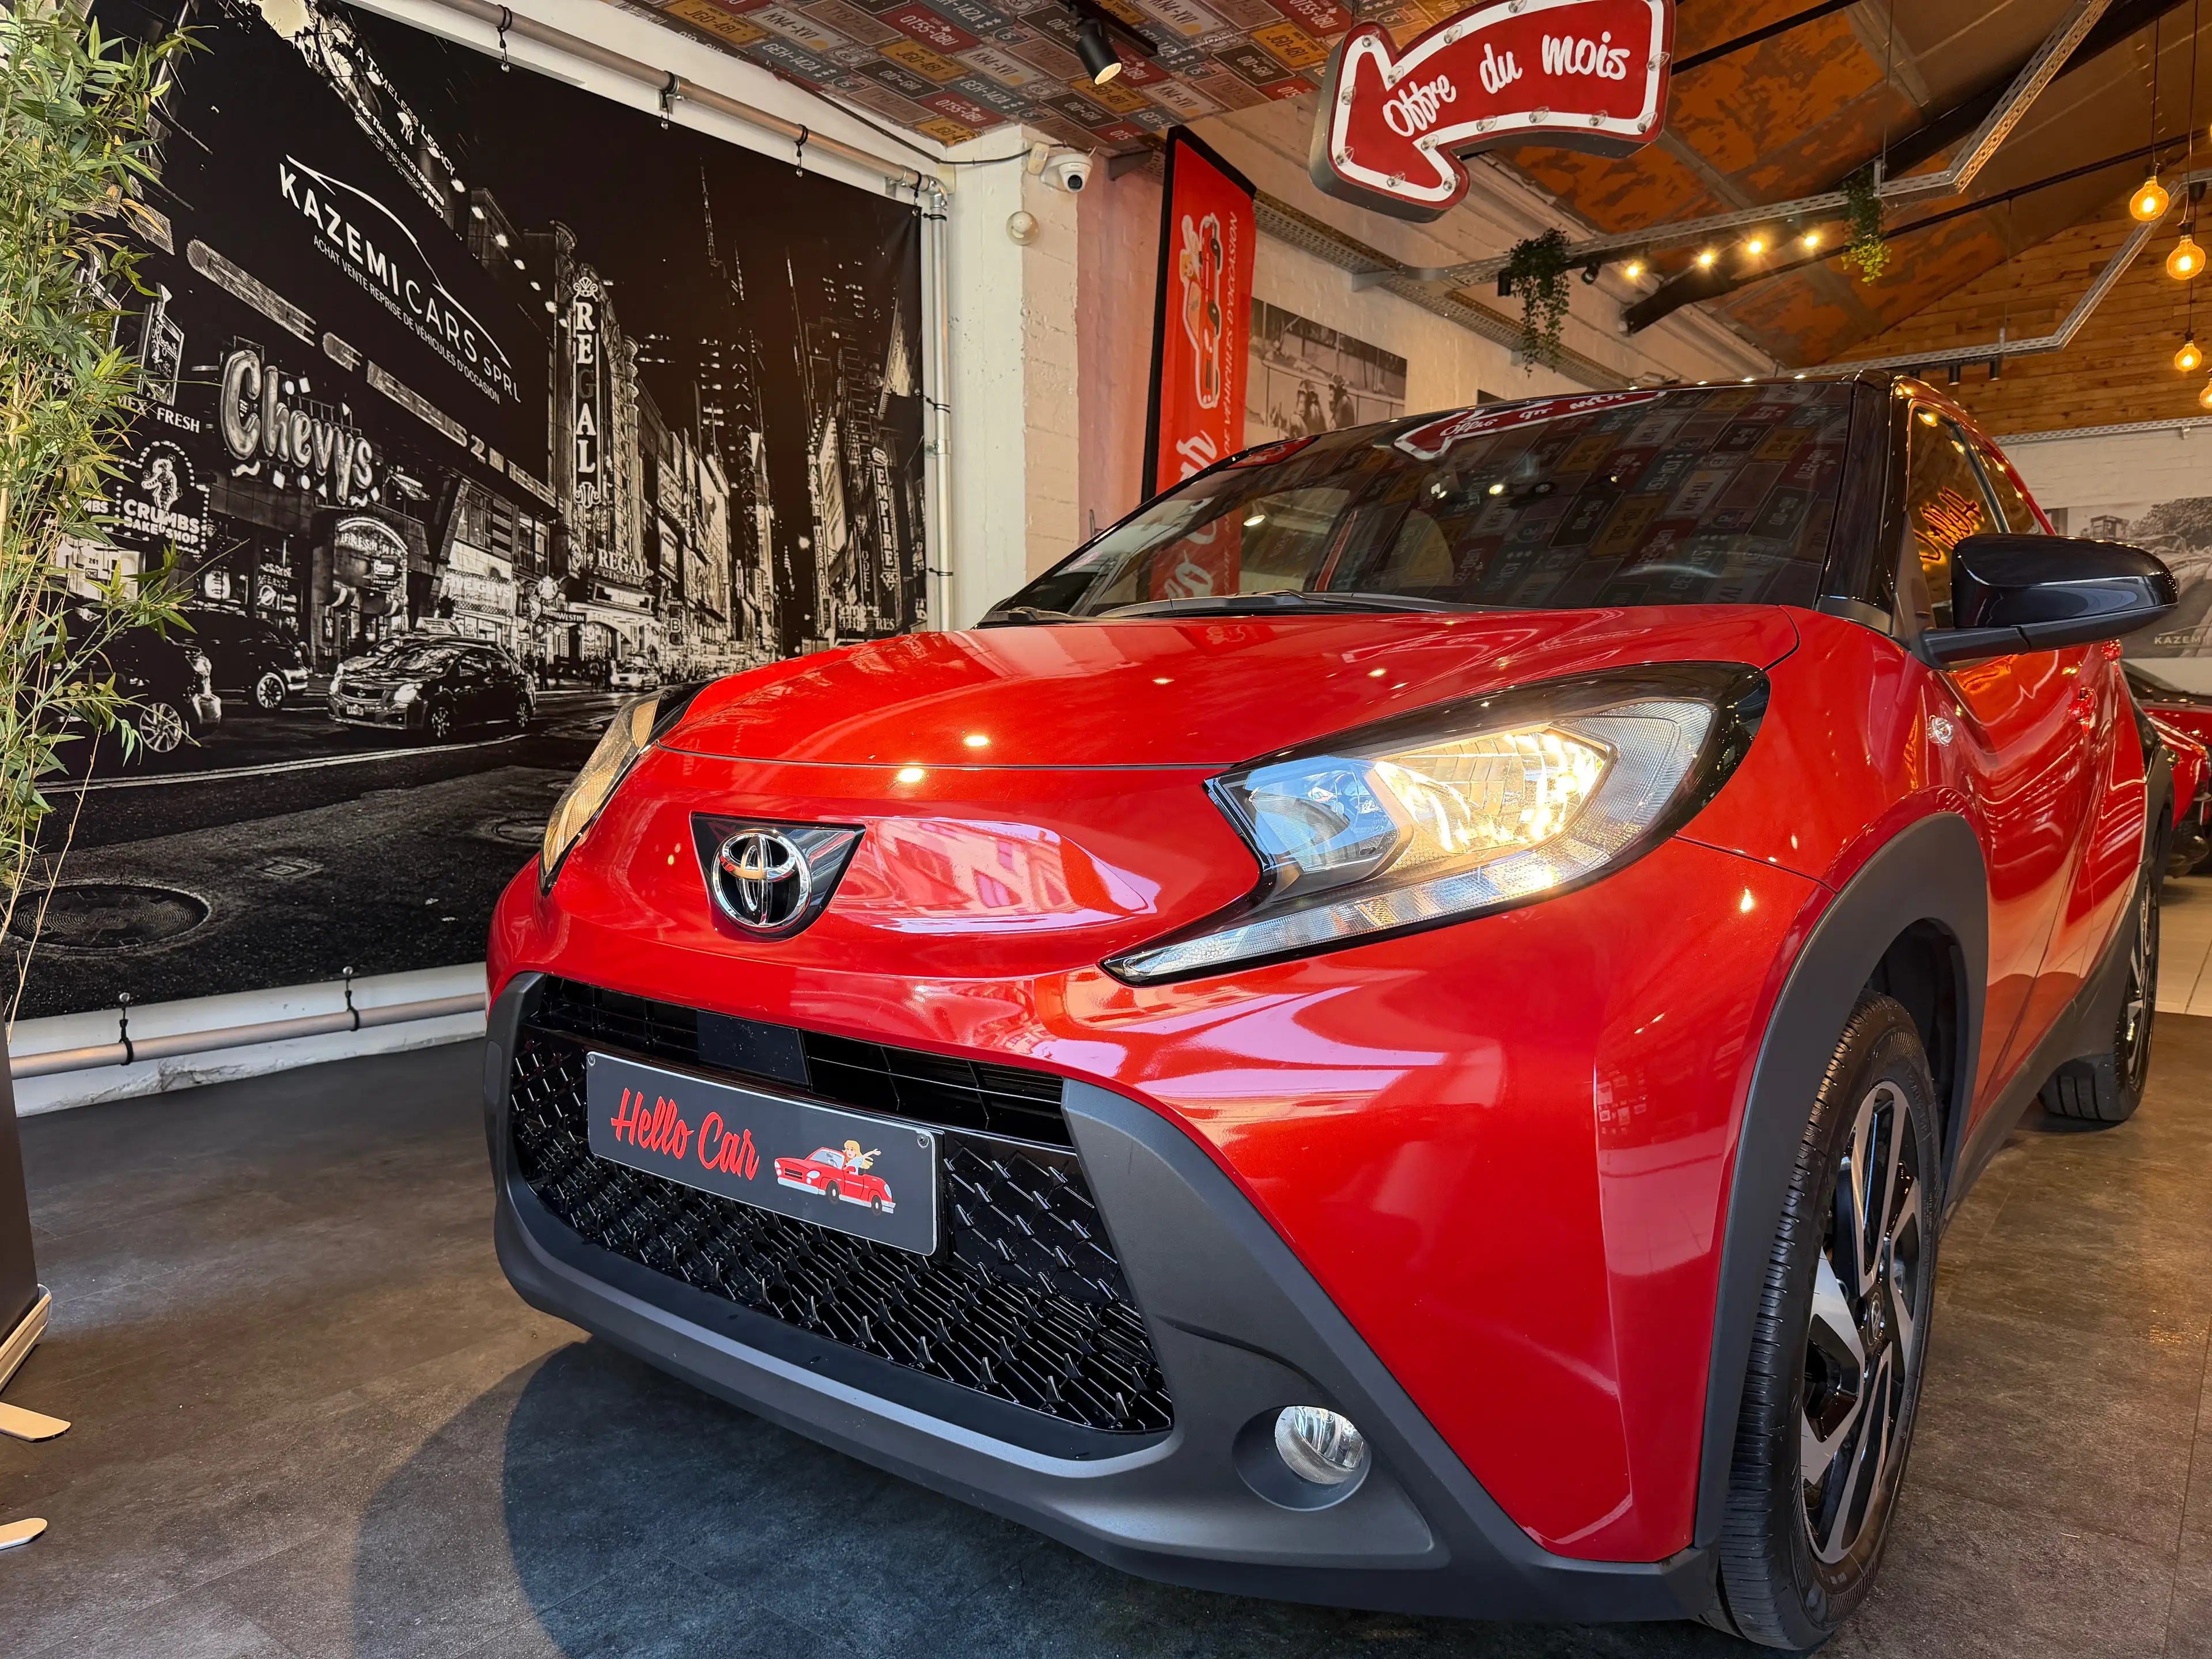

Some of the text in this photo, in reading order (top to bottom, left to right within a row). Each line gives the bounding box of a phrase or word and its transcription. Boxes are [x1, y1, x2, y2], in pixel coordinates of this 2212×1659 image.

[355, 47, 364, 63] A
[368, 55, 420, 127] TMELESS
[1382, 31, 1630, 138] Offre du mois
[279, 162, 399, 297] KAZEMI
[406, 280, 478, 363] CARS
[483, 356, 521, 403] SPRL
[313, 234, 501, 404] ACHAT VENTE REPRISE DE VÉHICULES D'OCCASION
[156, 406, 200, 433] FRESH
[220, 349, 373, 506] Chevys
[575, 302, 597, 474] REGAL
[123, 499, 200, 535] CRUMBS
[165, 529, 199, 545] SHOP
[597, 547, 647, 578] REGAL
[876, 467, 894, 567] EMPIRE
[558, 612, 584, 622] WESTIN
[611, 1087, 760, 1180] Hello Car
